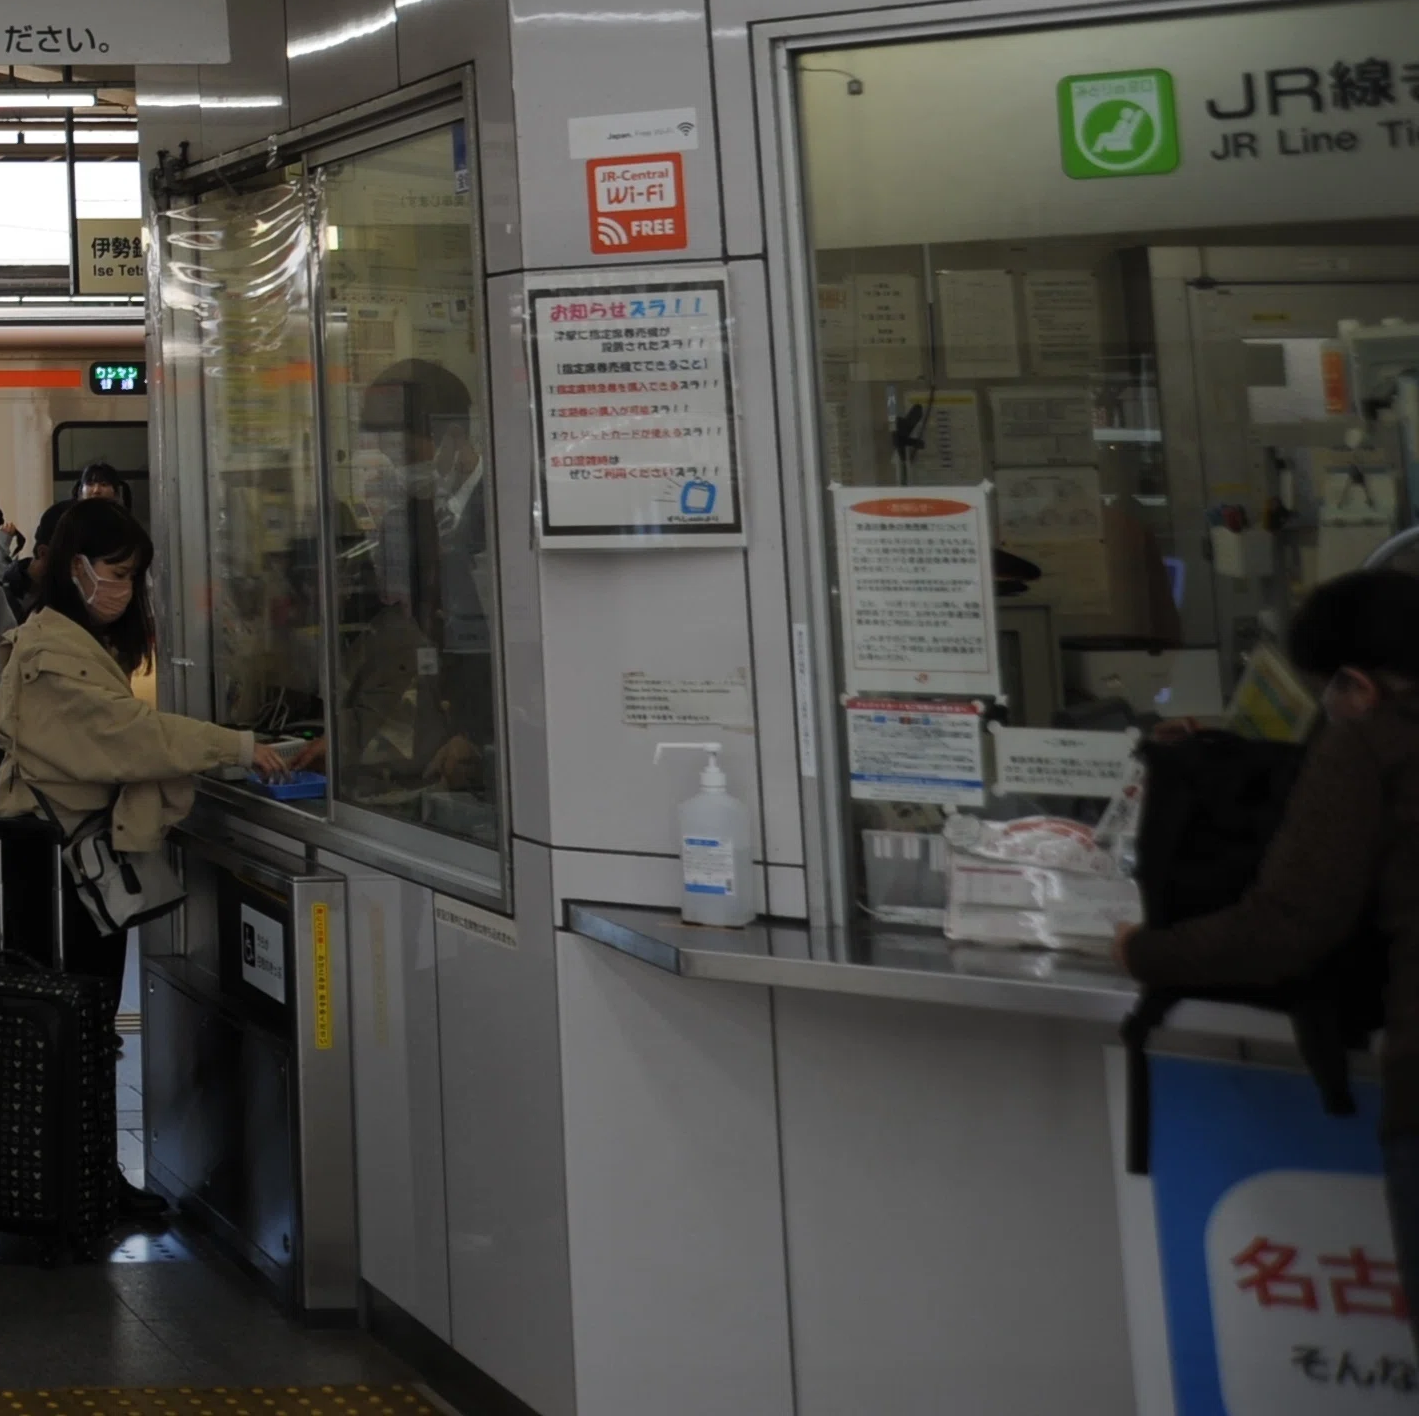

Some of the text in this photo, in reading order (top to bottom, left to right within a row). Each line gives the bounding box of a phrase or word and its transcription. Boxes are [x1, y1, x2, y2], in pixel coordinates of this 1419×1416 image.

[1211, 127, 1358, 160] JR Line
[600, 168, 669, 183] JR-Central
[607, 184, 664, 205] Wi-Fi
[631, 218, 675, 237] FREE
[93, 265, 114, 276] Ise
[95, 367, 138, 379] ワンマン
